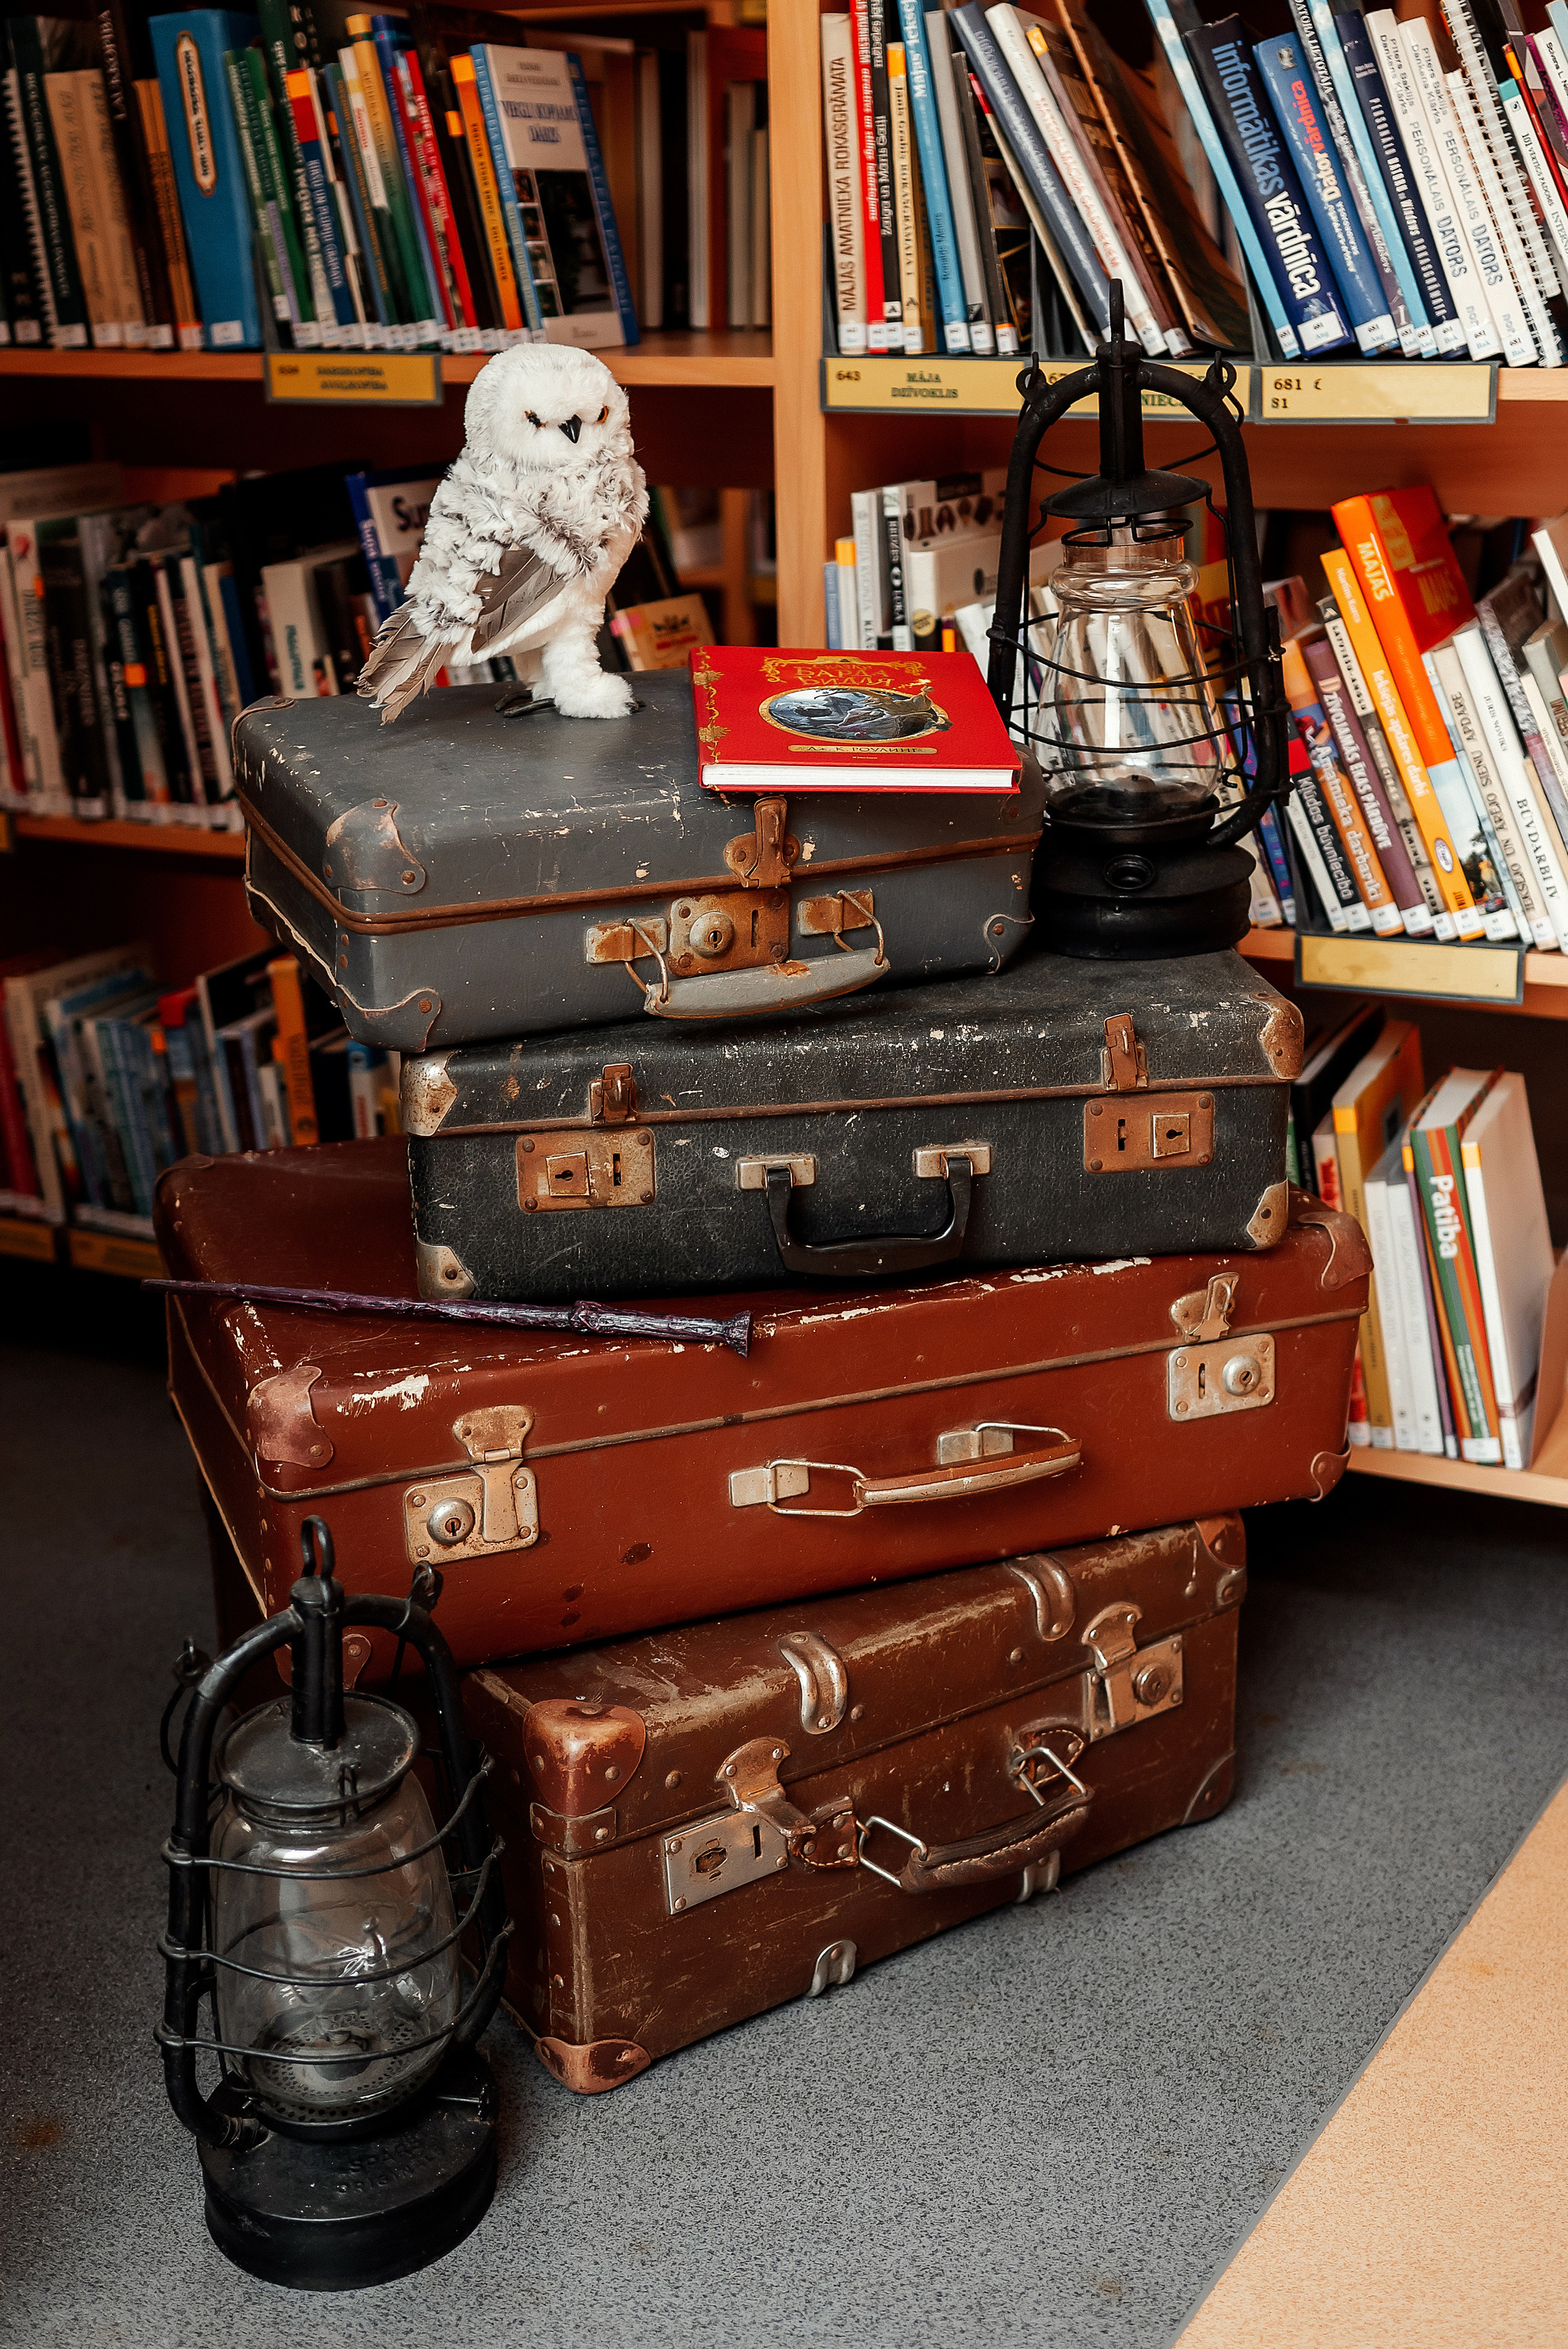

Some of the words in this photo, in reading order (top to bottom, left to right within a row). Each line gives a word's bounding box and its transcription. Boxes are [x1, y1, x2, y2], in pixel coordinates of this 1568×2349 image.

[826, 56, 851, 170] ROKASGRĀMATA
[862, 115, 873, 128] un
[1521, 132, 1532, 147] 101
[1212, 40, 1284, 196] informātikas
[1264, 190, 1322, 300] vārdnīca
[880, 184, 891, 199] un
[1408, 121, 1446, 212] PERSONĀLAIS
[1436, 215, 1468, 279] DATORS
[1444, 130, 1479, 221] PERSONĀLAIS
[1471, 224, 1504, 287] DATORS
[834, 176, 855, 256] AMATNIEKA
[880, 200, 894, 236] Zaiga
[1399, 198, 1422, 236] Windows
[836, 370, 861, 381] 643
[907, 371, 941, 382] MĀJA
[1274, 378, 1302, 390] 681
[794, 666, 888, 678] БАРДА
[794, 675, 895, 687] БИЛЛЯ
[1449, 690, 1478, 742] APDARE
[1311, 741, 1360, 828] Amatnieka
[1405, 762, 1430, 798] darbi
[1469, 748, 1493, 787] SIENU
[1500, 837, 1517, 857] UN
[1515, 796, 1555, 882] BŪVDARBI
[1545, 883, 1561, 902] IV
